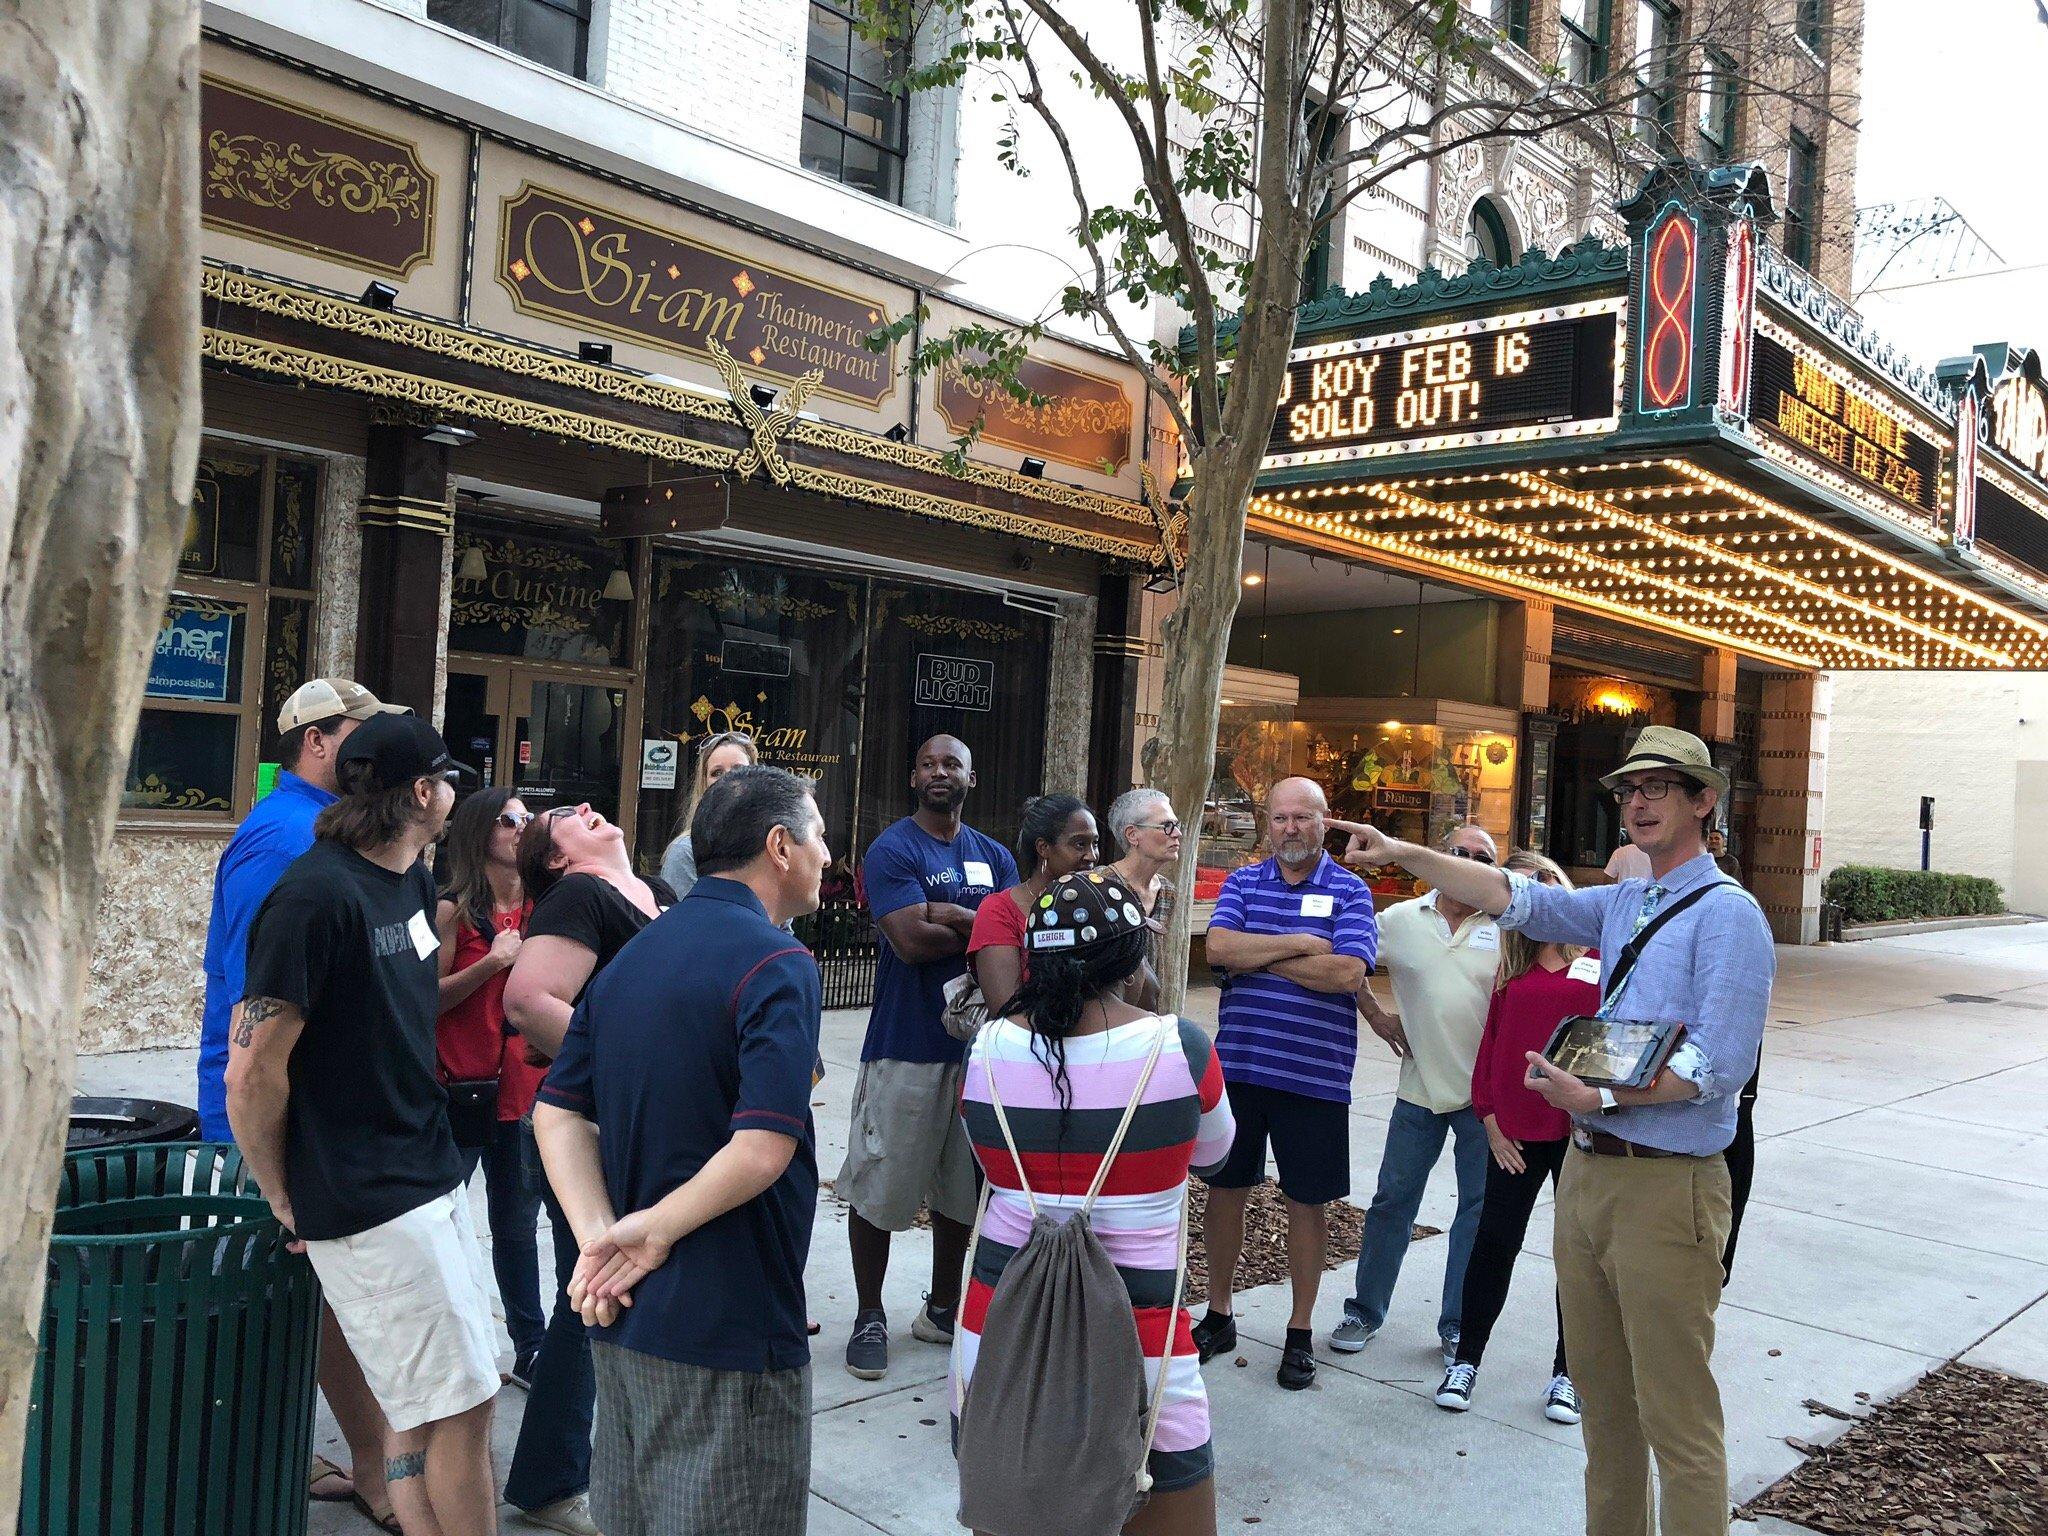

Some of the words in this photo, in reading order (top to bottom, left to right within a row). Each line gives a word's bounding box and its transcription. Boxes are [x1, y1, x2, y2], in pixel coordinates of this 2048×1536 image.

[525, 211, 746, 342] Si-am
[756, 291, 887, 357] Thaimeric
[762, 325, 881, 383] Restaurant
[1312, 354, 1380, 401] KOY
[1402, 340, 1472, 388] FEB
[1495, 332, 1530, 376] 16
[1290, 395, 1374, 442] SOLD
[1396, 381, 1480, 429] OUT!
[1993, 376, 2048, 482] TAMP
[1852, 434, 1882, 482] FEB
[491, 569, 602, 611] Cuisine
[173, 646, 221, 661] mayor
[931, 659, 981, 684] BUD
[148, 676, 215, 689] eImpossible
[919, 678, 990, 706] LIGHT
[776, 750, 841, 764] Restaurant
[1384, 790, 1422, 805] Nature
[1037, 932, 1065, 943] LEHIGH
